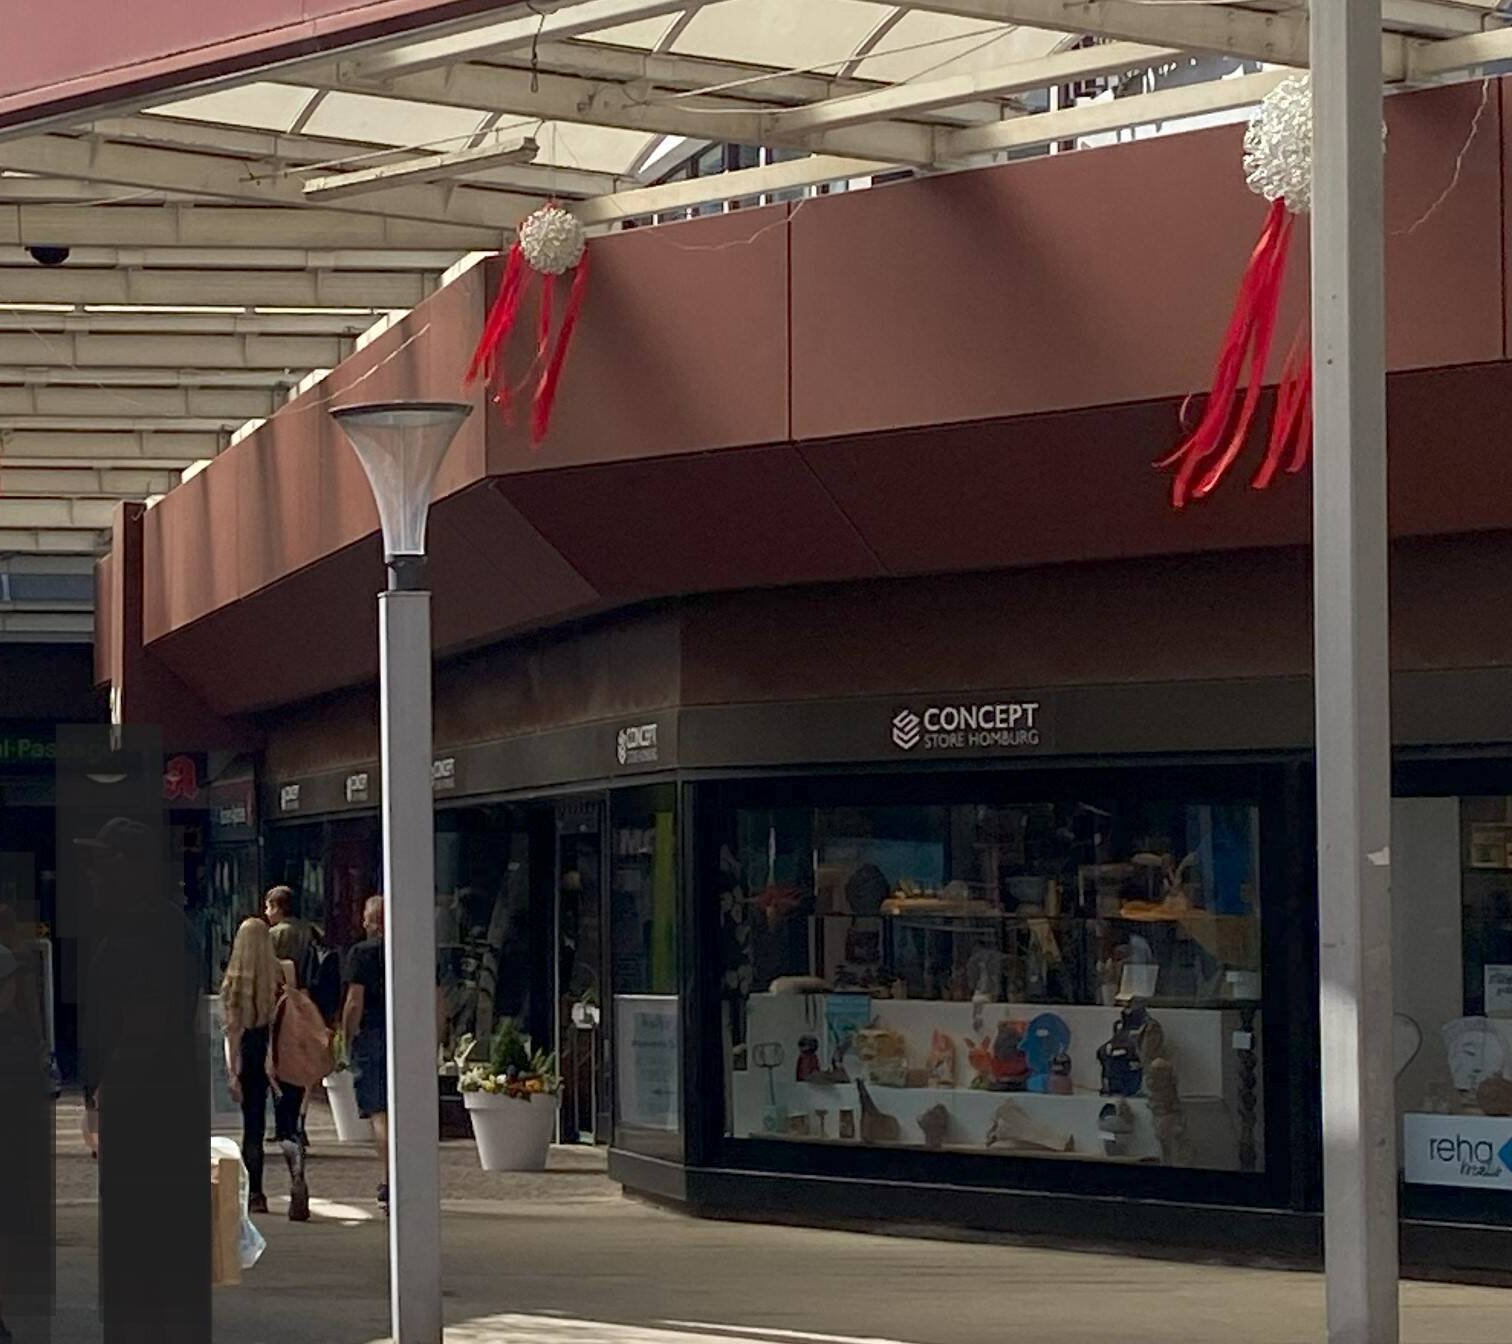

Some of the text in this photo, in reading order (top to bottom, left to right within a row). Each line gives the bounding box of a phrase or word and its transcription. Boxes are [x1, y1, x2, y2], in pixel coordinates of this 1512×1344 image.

[923, 702, 1039, 732] CONCEPT
[924, 728, 1040, 750] STORE HOMBURG
[1429, 1132, 1494, 1164] reha
